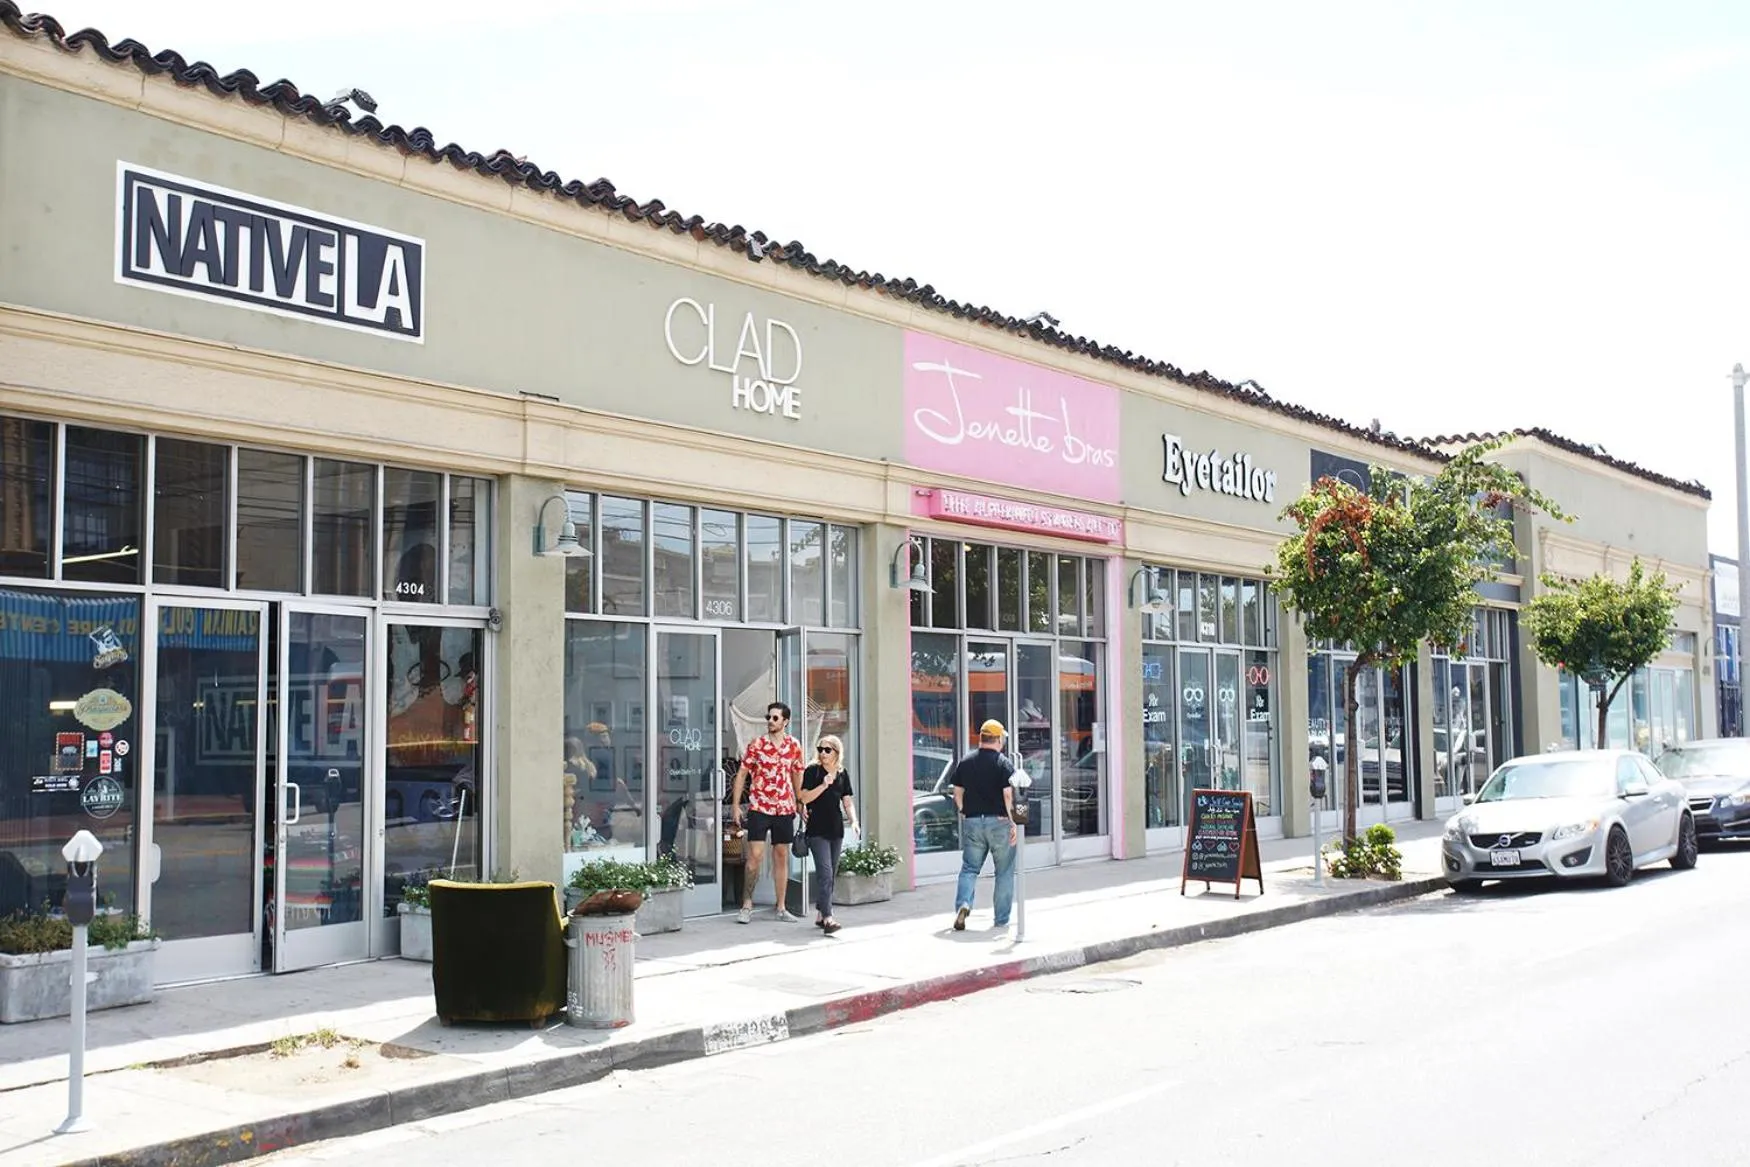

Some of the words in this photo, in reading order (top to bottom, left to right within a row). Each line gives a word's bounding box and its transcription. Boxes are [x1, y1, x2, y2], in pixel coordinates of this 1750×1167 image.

[135, 185, 336, 308] NATIVE
[343, 233, 415, 330] LA
[664, 297, 802, 385] CLAD
[732, 374, 802, 420] HOME
[911, 356, 1061, 453] Jenette
[1061, 396, 1116, 468] bras
[1161, 433, 1278, 503] Eyetailor
[395, 581, 425, 595] 4304
[706, 600, 732, 616] 4306
[1143, 708, 1167, 722] Exam
[1250, 708, 1271, 721] Exam
[669, 728, 702, 744] CLAD
